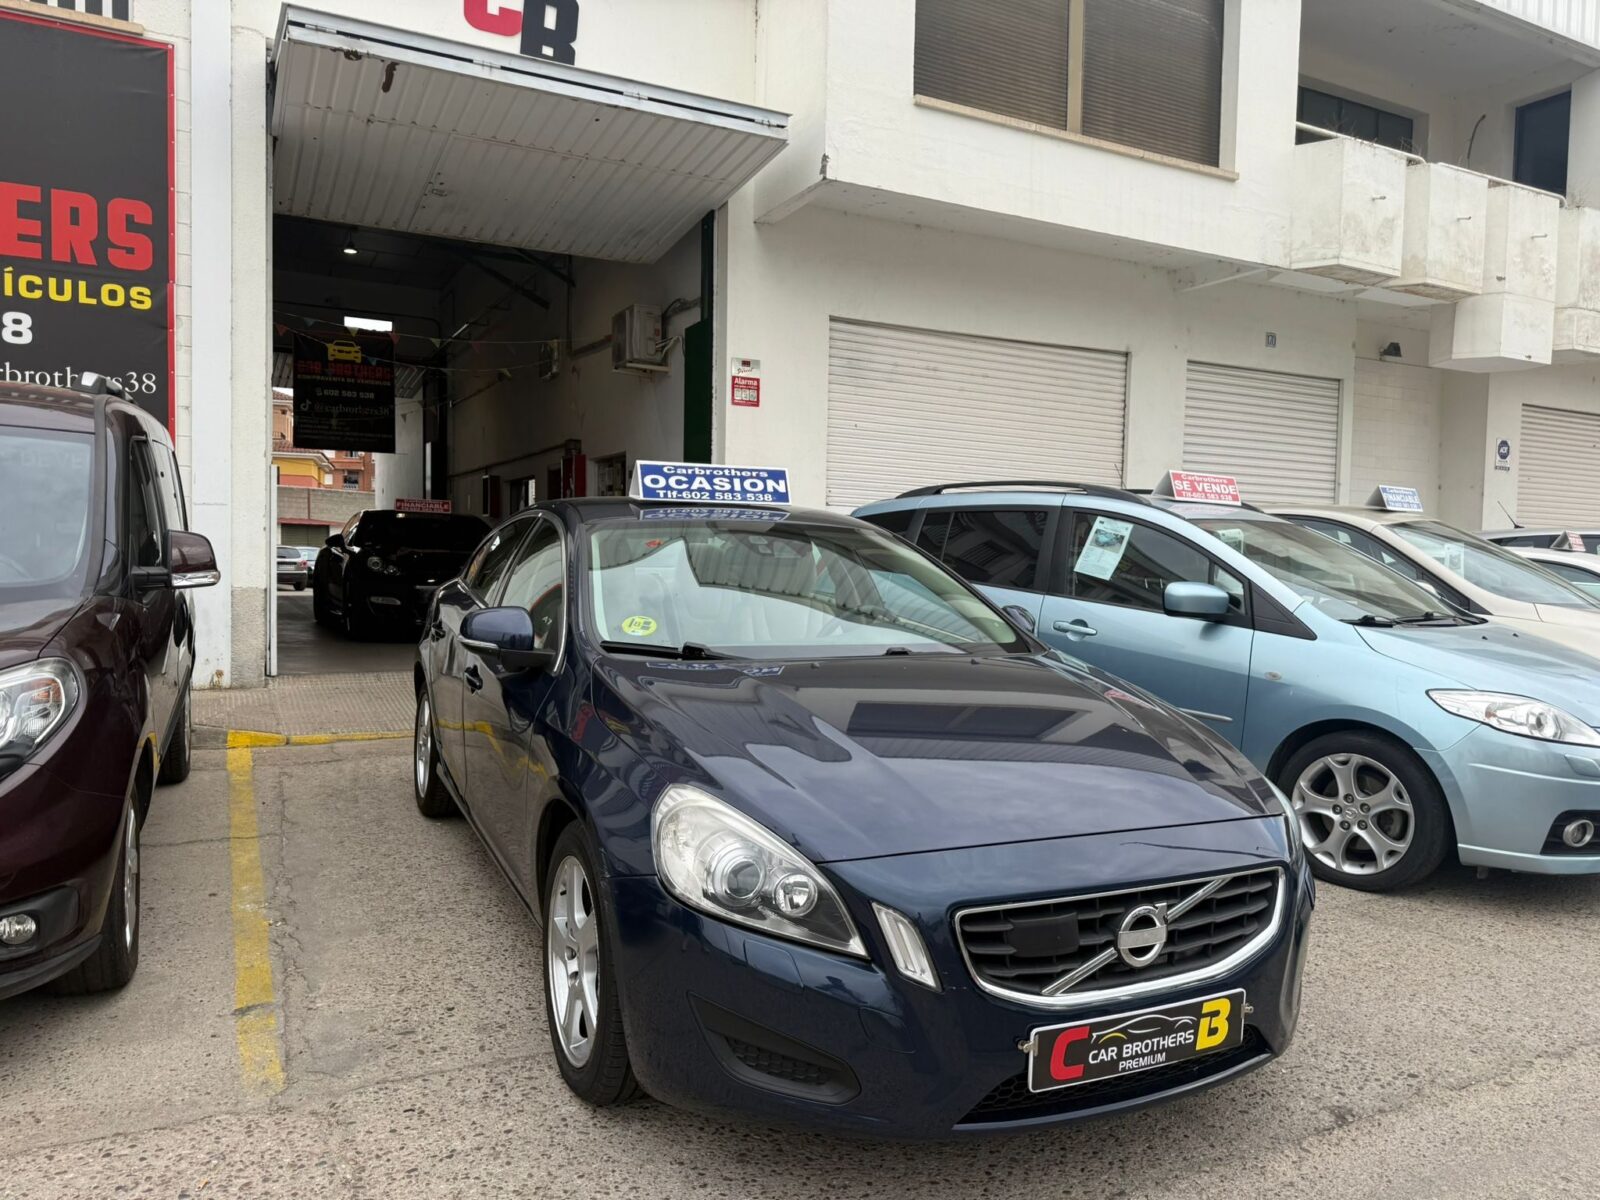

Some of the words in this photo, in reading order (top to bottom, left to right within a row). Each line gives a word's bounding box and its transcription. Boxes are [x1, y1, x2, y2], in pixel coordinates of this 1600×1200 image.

[0, 181, 153, 271] ERS
[3, 265, 152, 310] ÍCULOS
[1, 311, 33, 345] 8
[734, 377, 758, 386] Alarma
[663, 466, 769, 478] Carbrothers
[643, 474, 787, 493] OCASION
[1174, 480, 1192, 491] SE
[1194, 482, 1237, 495] VENDE
[396, 501, 449, 509] FINANCIABLE
[715, 491, 742, 501] 583
[746, 492, 773, 502] 538
[1088, 1046, 1118, 1065] CAR
[1122, 1029, 1196, 1058] BROTHERS
[1118, 1052, 1166, 1072] PREMIUM
